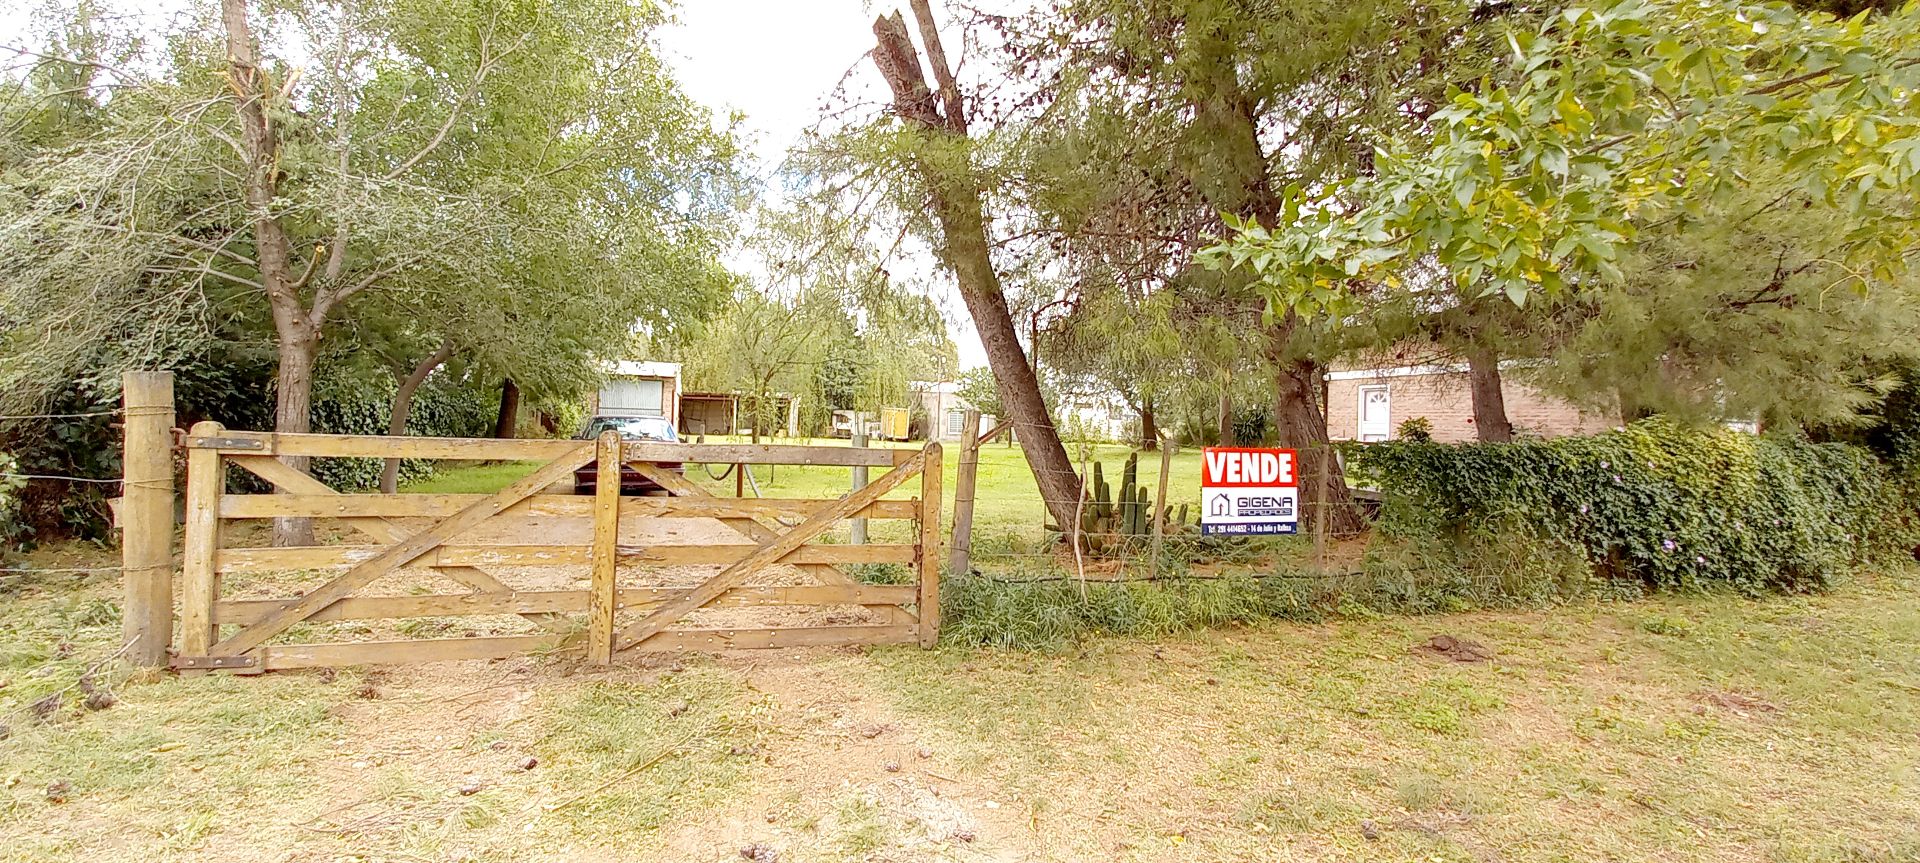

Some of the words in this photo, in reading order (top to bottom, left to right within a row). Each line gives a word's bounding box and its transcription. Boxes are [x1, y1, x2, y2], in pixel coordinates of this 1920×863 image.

[1205, 452, 1293, 483] VENDE
[1237, 497, 1292, 507] GIGENA
[1250, 524, 1256, 533] 14
[1257, 524, 1262, 532] de
[1263, 523, 1273, 532] Julio
